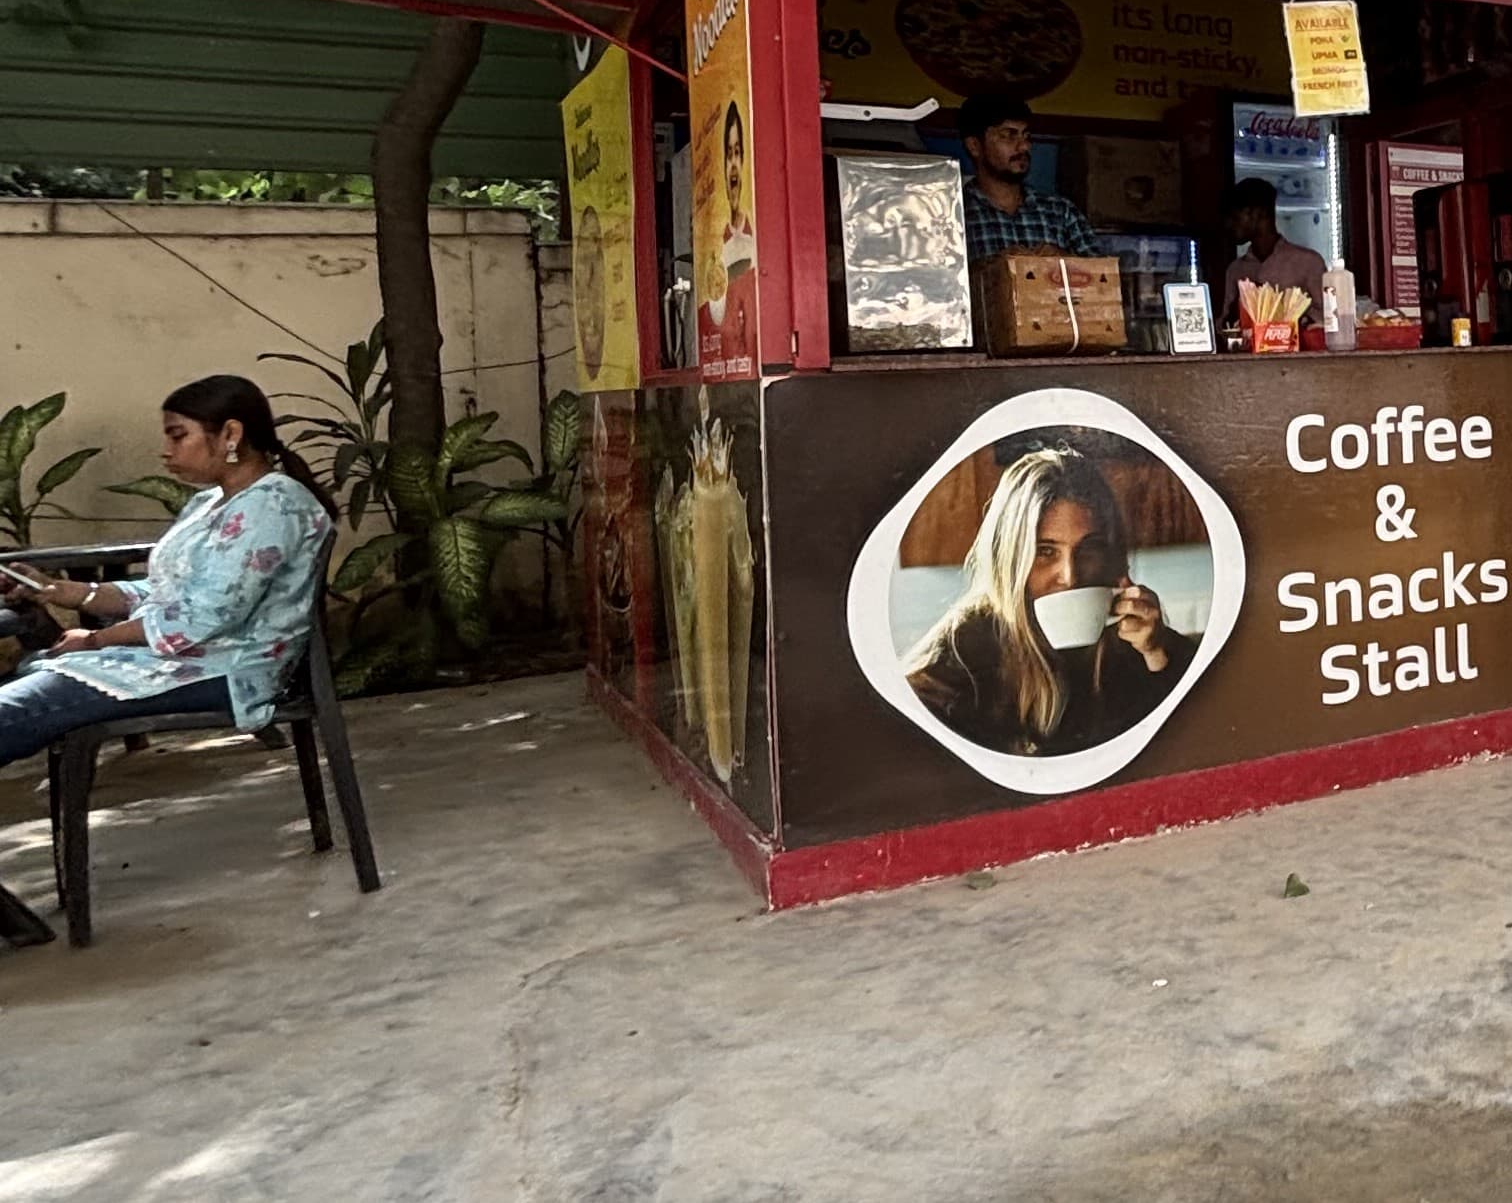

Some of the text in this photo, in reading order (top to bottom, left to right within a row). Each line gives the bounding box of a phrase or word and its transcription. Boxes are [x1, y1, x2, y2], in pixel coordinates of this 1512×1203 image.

[1162, 0, 1232, 45] long
[1295, 17, 1350, 30] AVAILABLE
[1113, 44, 1262, 79] non-sticky,
[1312, 51, 1338, 60] UPMA
[1115, 76, 1168, 98] and
[1303, 82, 1335, 91] FRENCH
[1285, 404, 1493, 474] Coffee
[1374, 484, 1418, 543] &
[1277, 550, 1509, 634] Snacks
[1320, 623, 1478, 706] Stall
